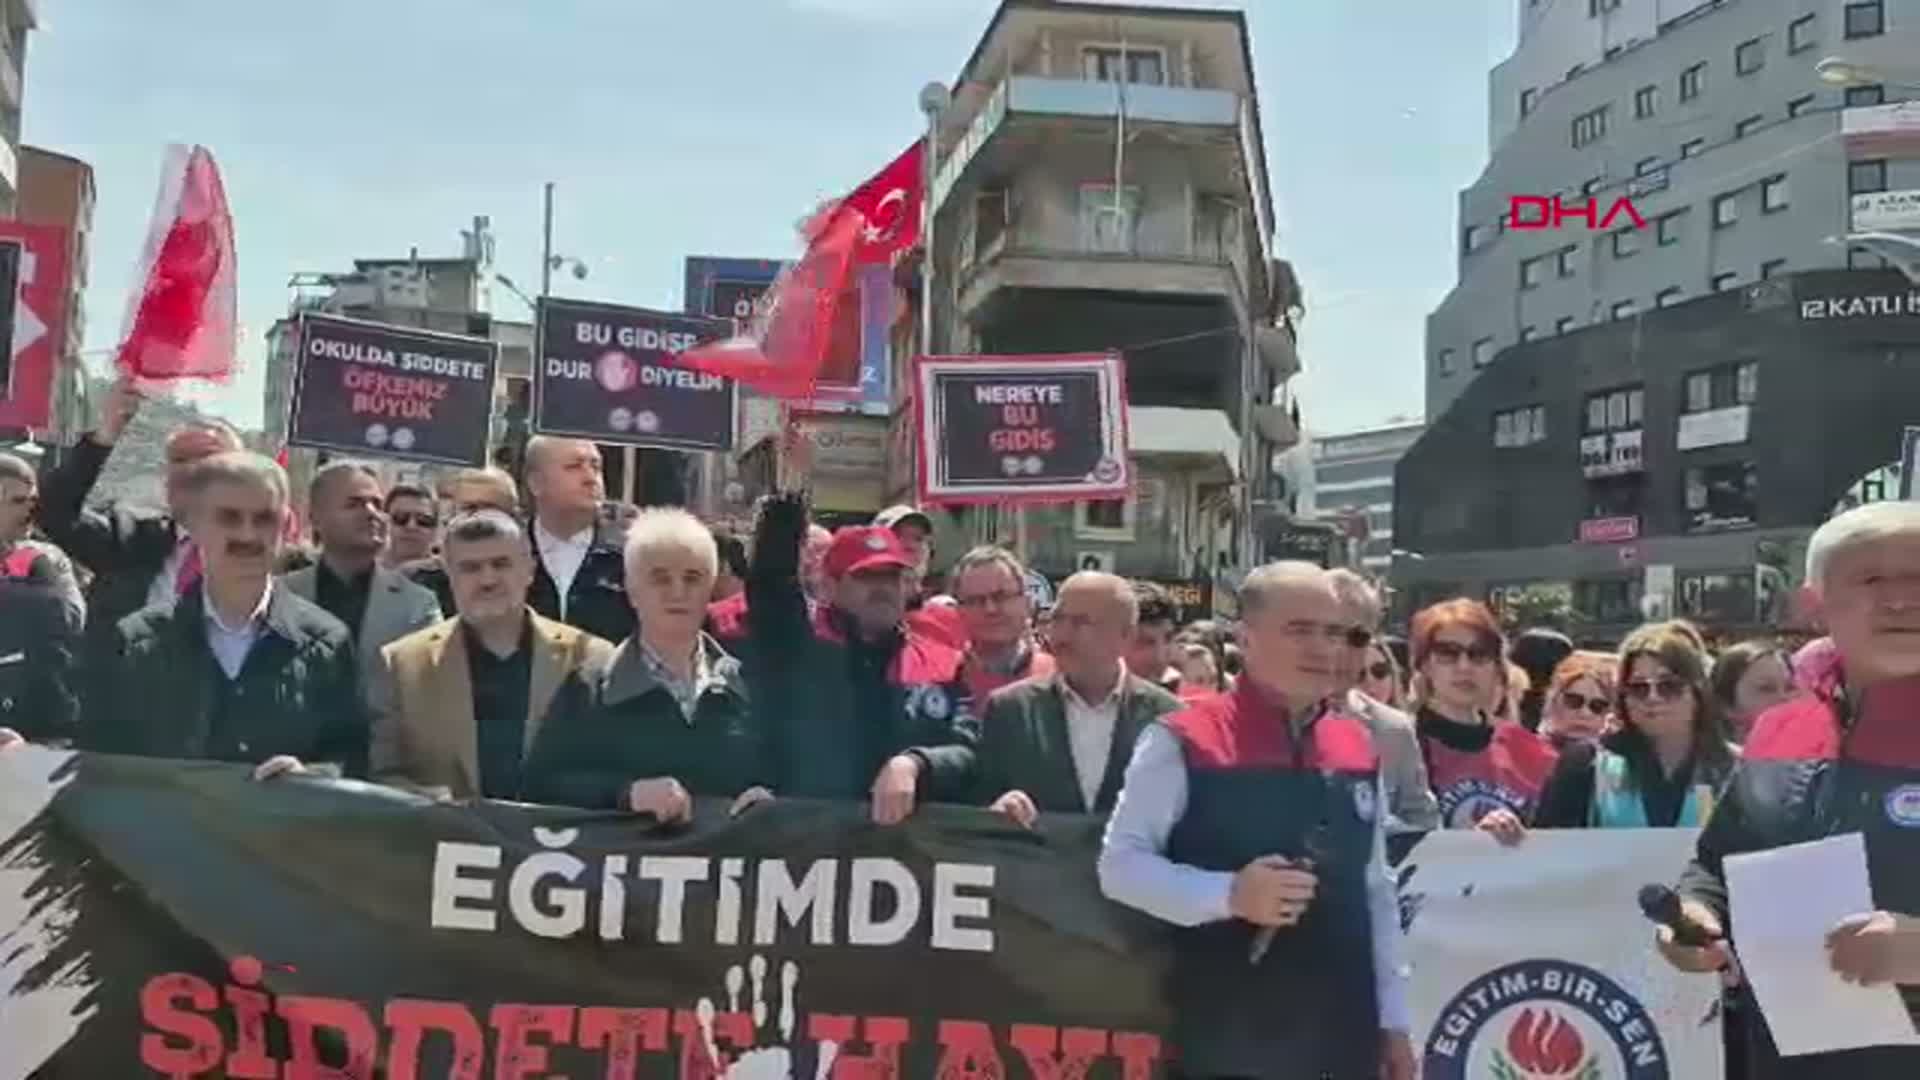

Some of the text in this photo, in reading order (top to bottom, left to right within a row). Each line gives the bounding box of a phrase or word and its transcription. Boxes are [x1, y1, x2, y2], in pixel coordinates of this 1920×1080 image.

[576, 322, 612, 345] BU
[310, 338, 395, 367] OKULDA
[546, 358, 592, 380] DUR
[976, 384, 1062, 404] NEREYE
[1003, 405, 1037, 426] BU
[431, 826, 997, 953] EĞİTİMDE
